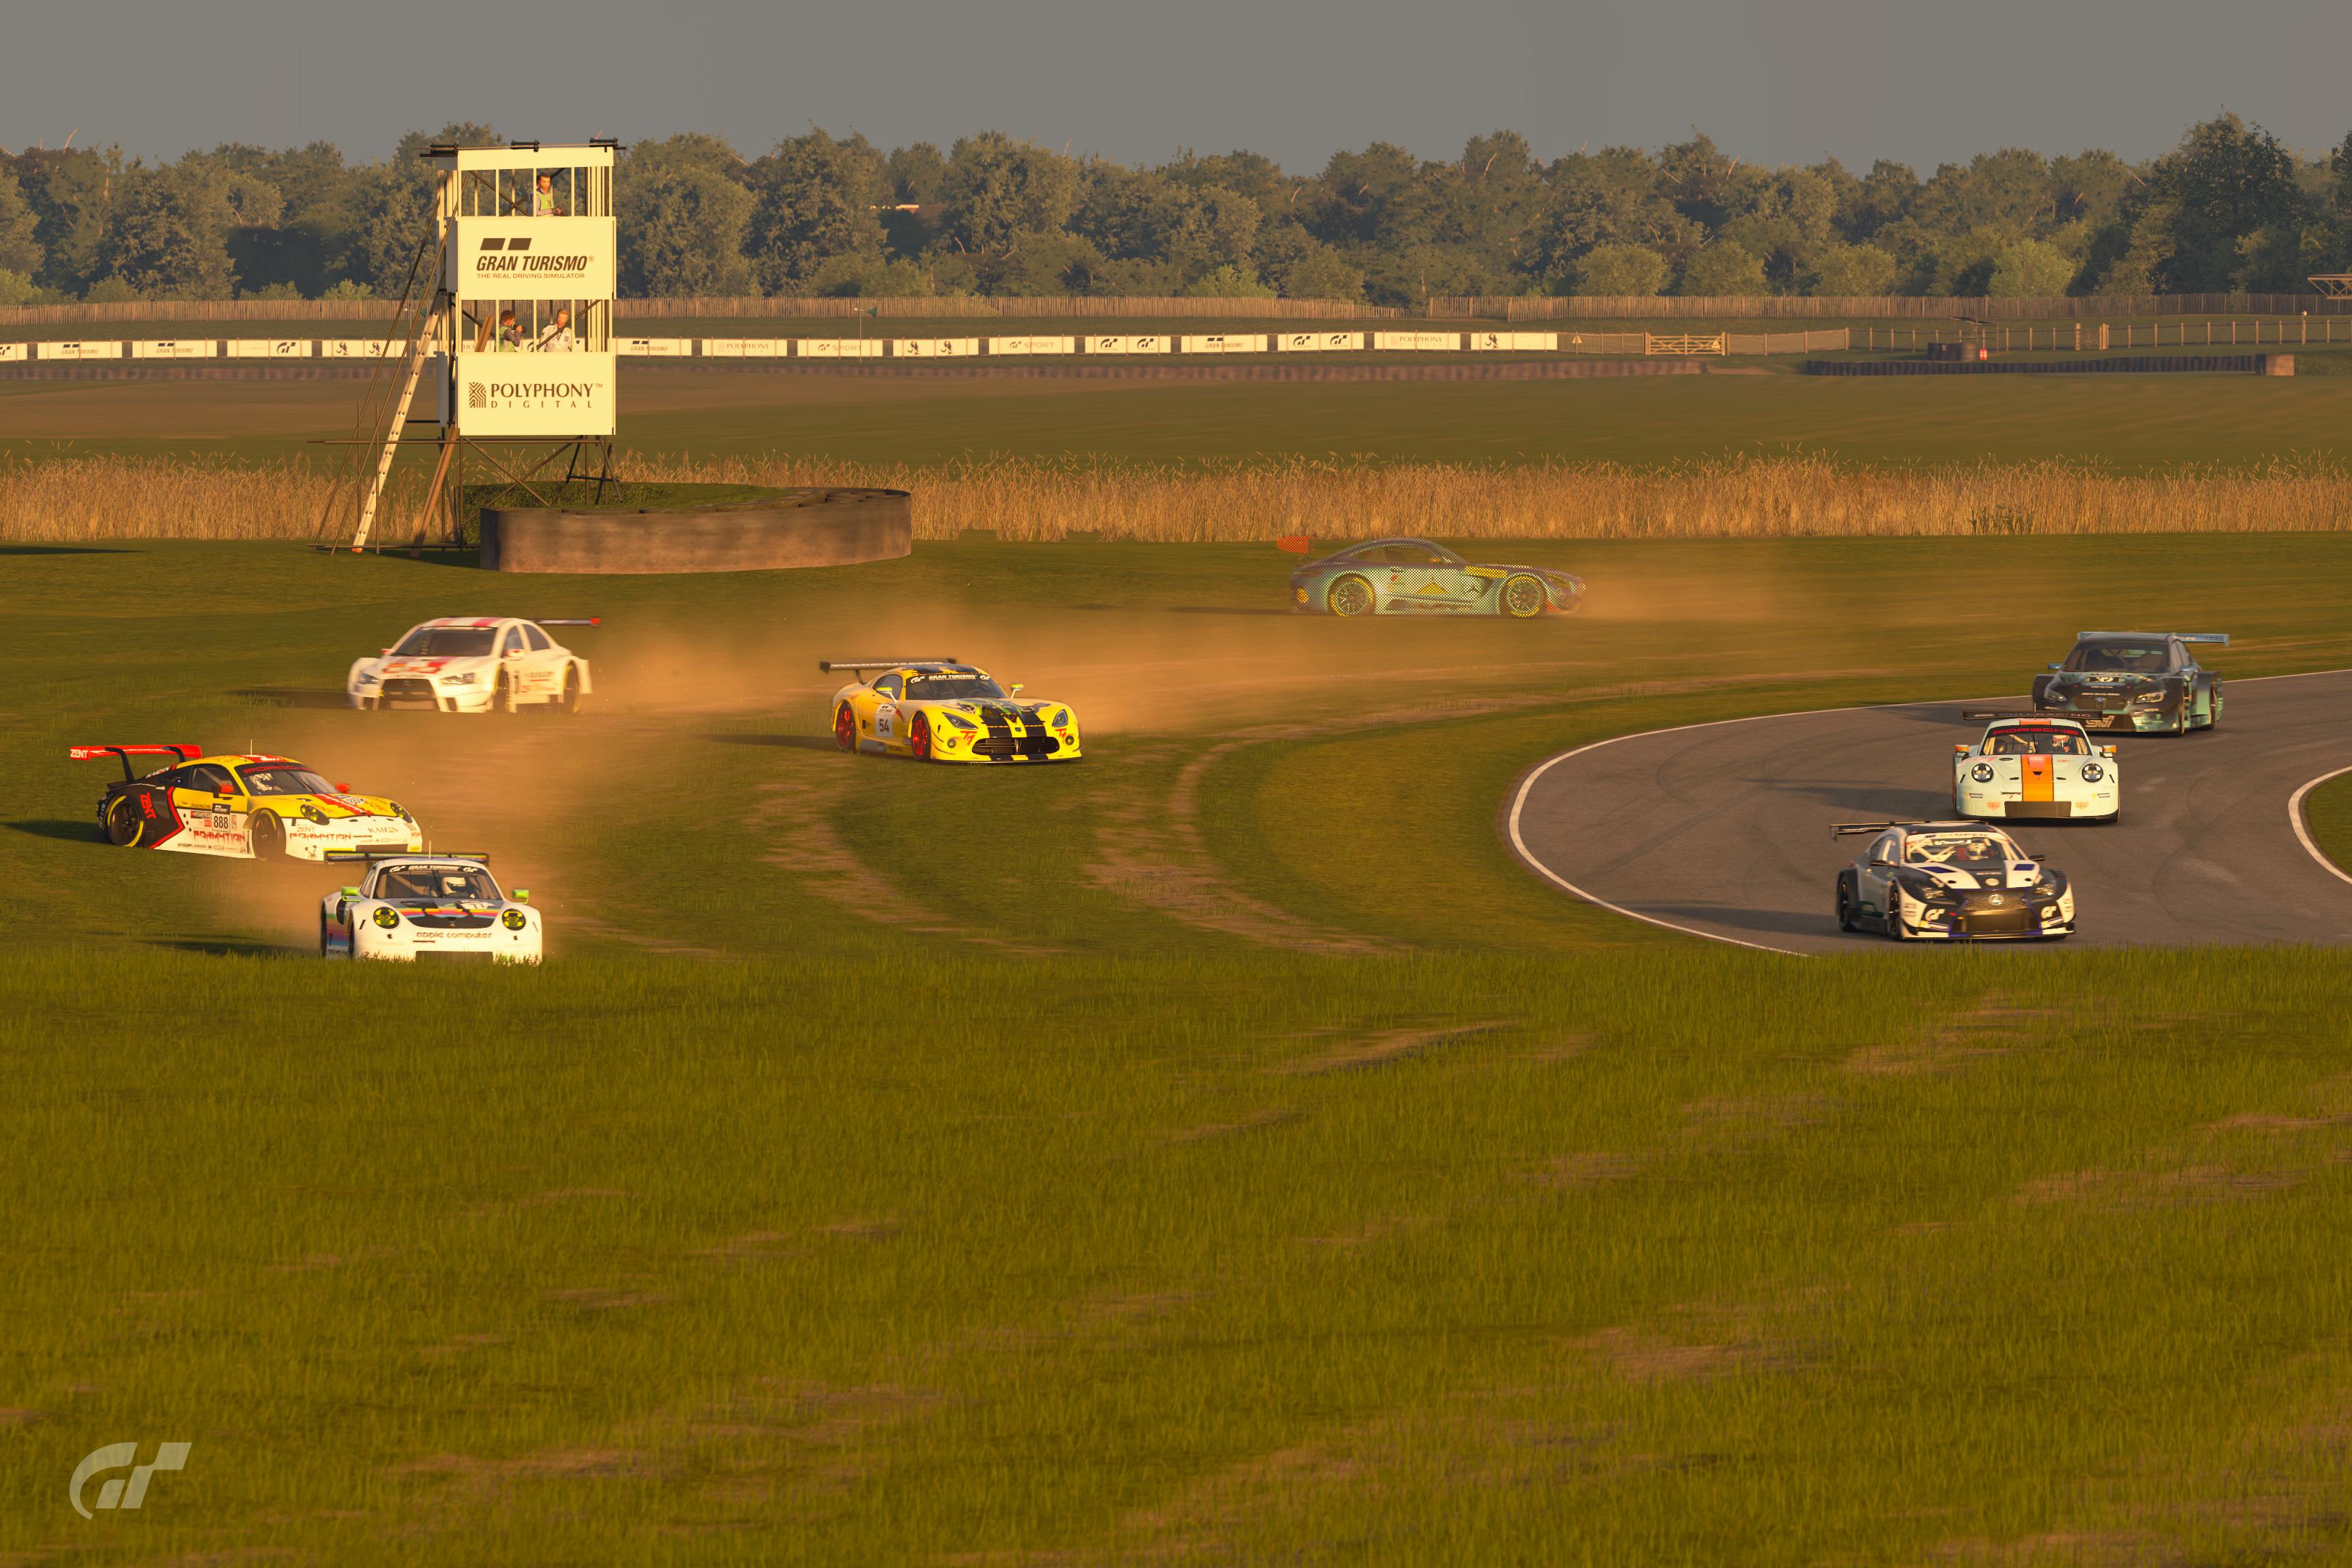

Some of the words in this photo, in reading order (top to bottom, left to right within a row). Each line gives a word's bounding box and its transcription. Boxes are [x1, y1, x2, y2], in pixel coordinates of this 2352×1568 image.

[476, 256, 518, 271] GRAN
[879, 719, 890, 732] 54
[70, 749, 89, 759] ZENT
[139, 792, 157, 820] ZENT
[213, 815, 229, 830] 888
